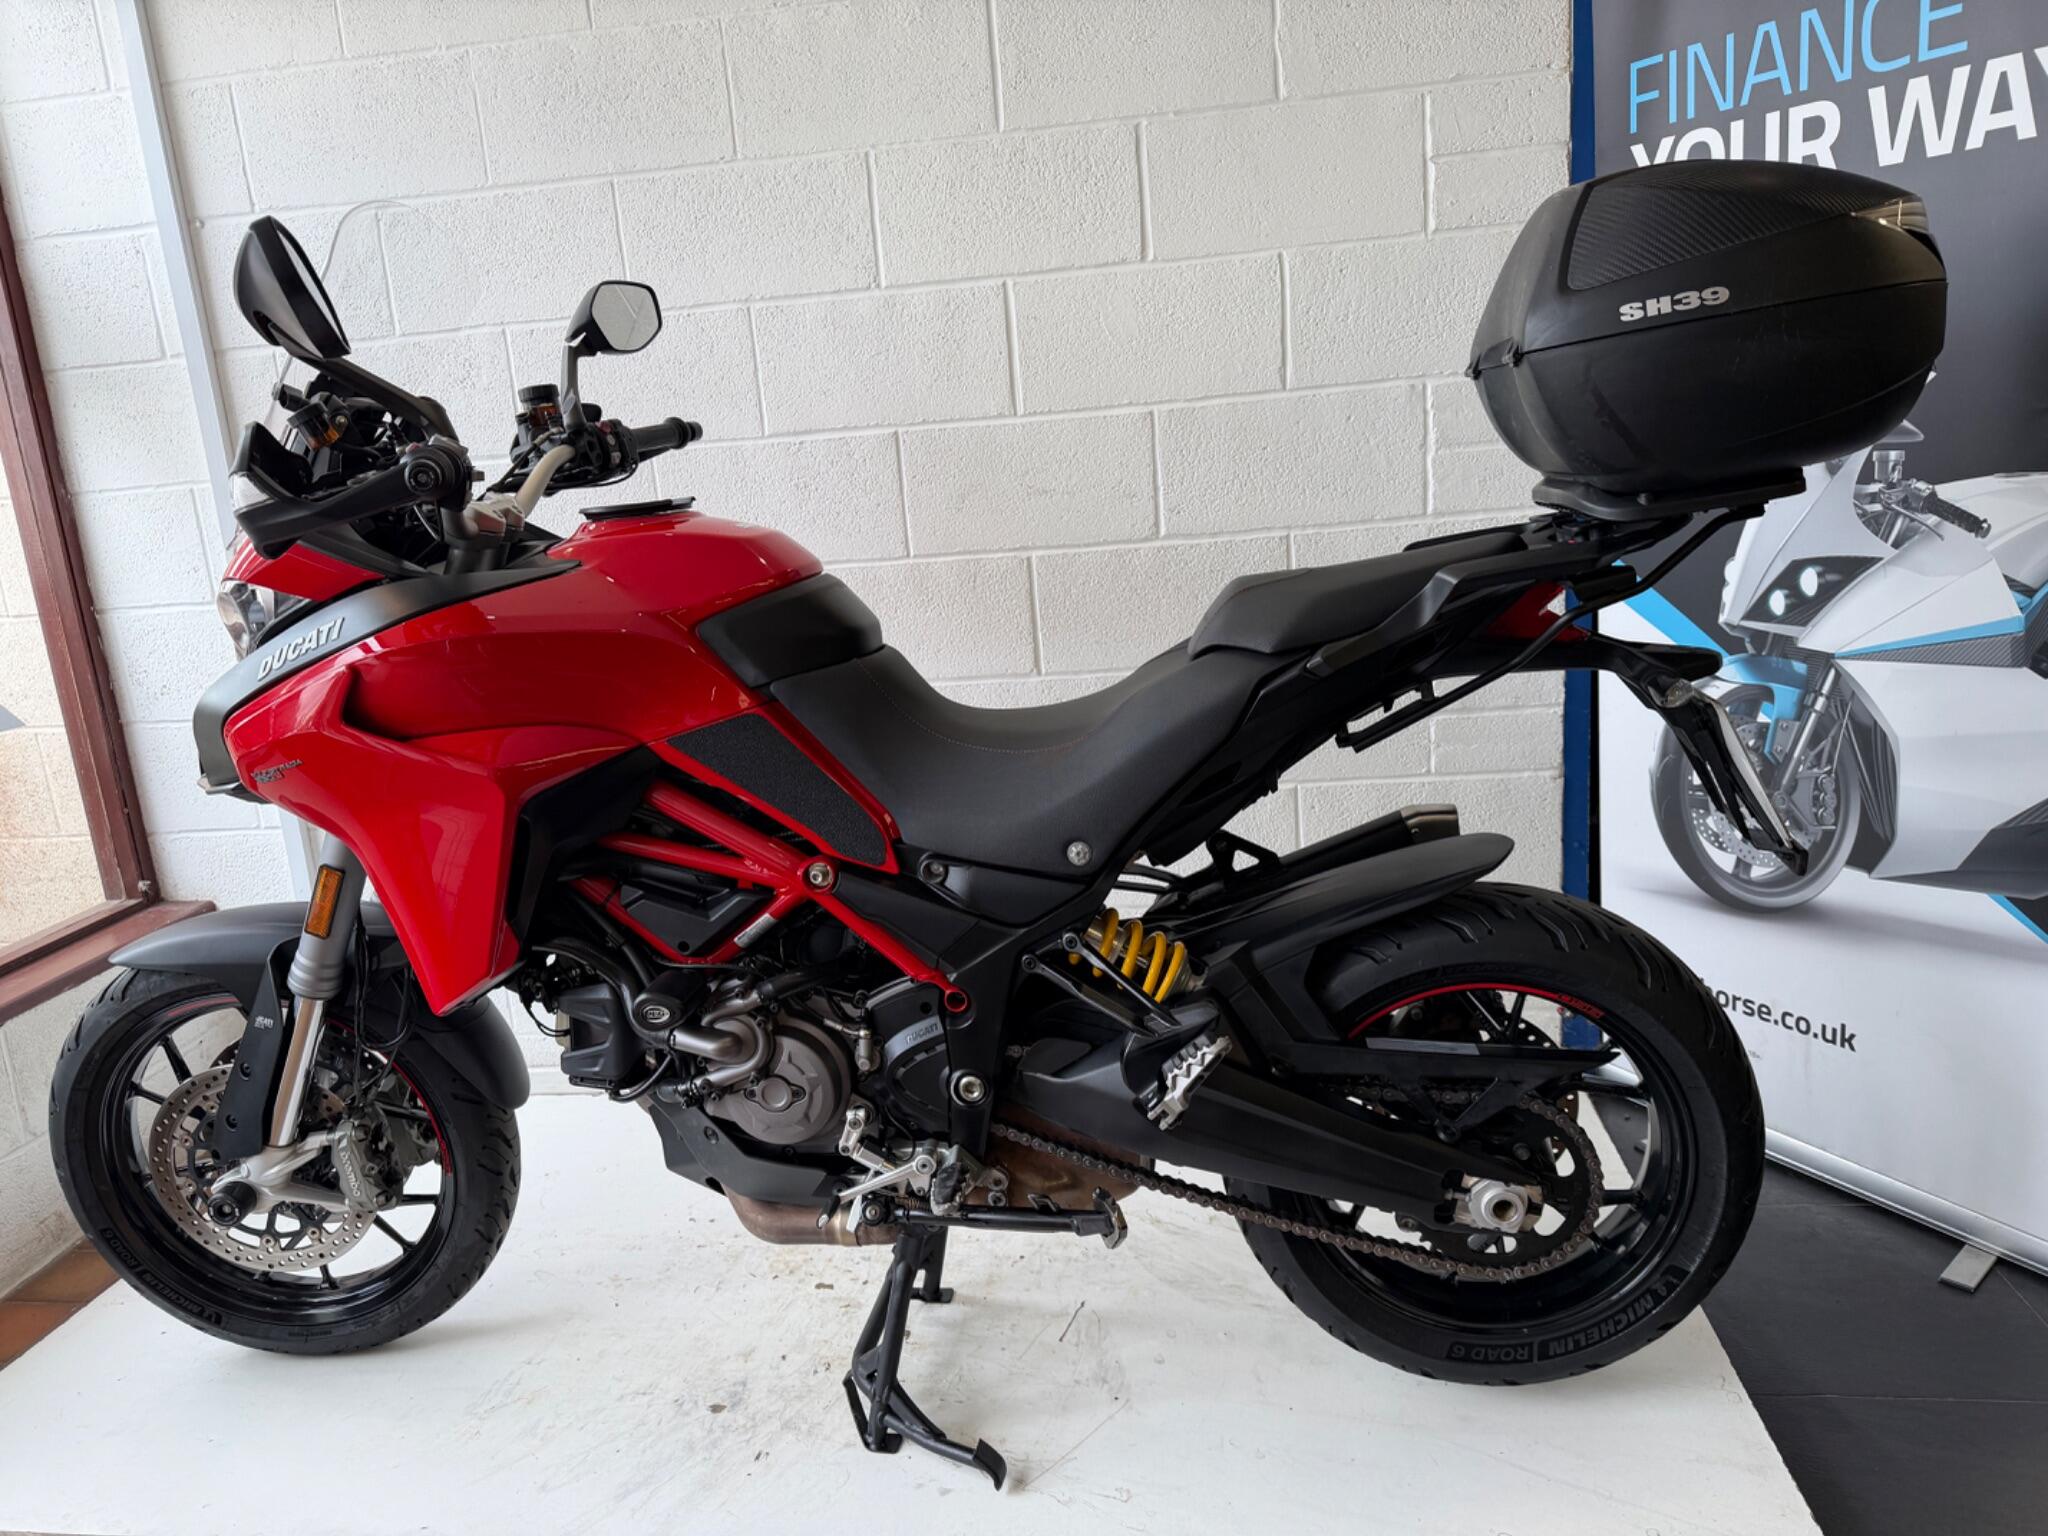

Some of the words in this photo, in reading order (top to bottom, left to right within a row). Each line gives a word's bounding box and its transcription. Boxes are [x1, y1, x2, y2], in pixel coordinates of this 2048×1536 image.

[1629, 0, 1968, 134] FINANCE
[1867, 45, 2048, 167] WA
[1619, 286, 1730, 322] SH39
[257, 616, 345, 681] DUCATI
[1470, 1346, 1529, 1361] ROAD
[1548, 1292, 1655, 1357] MICHELIN
